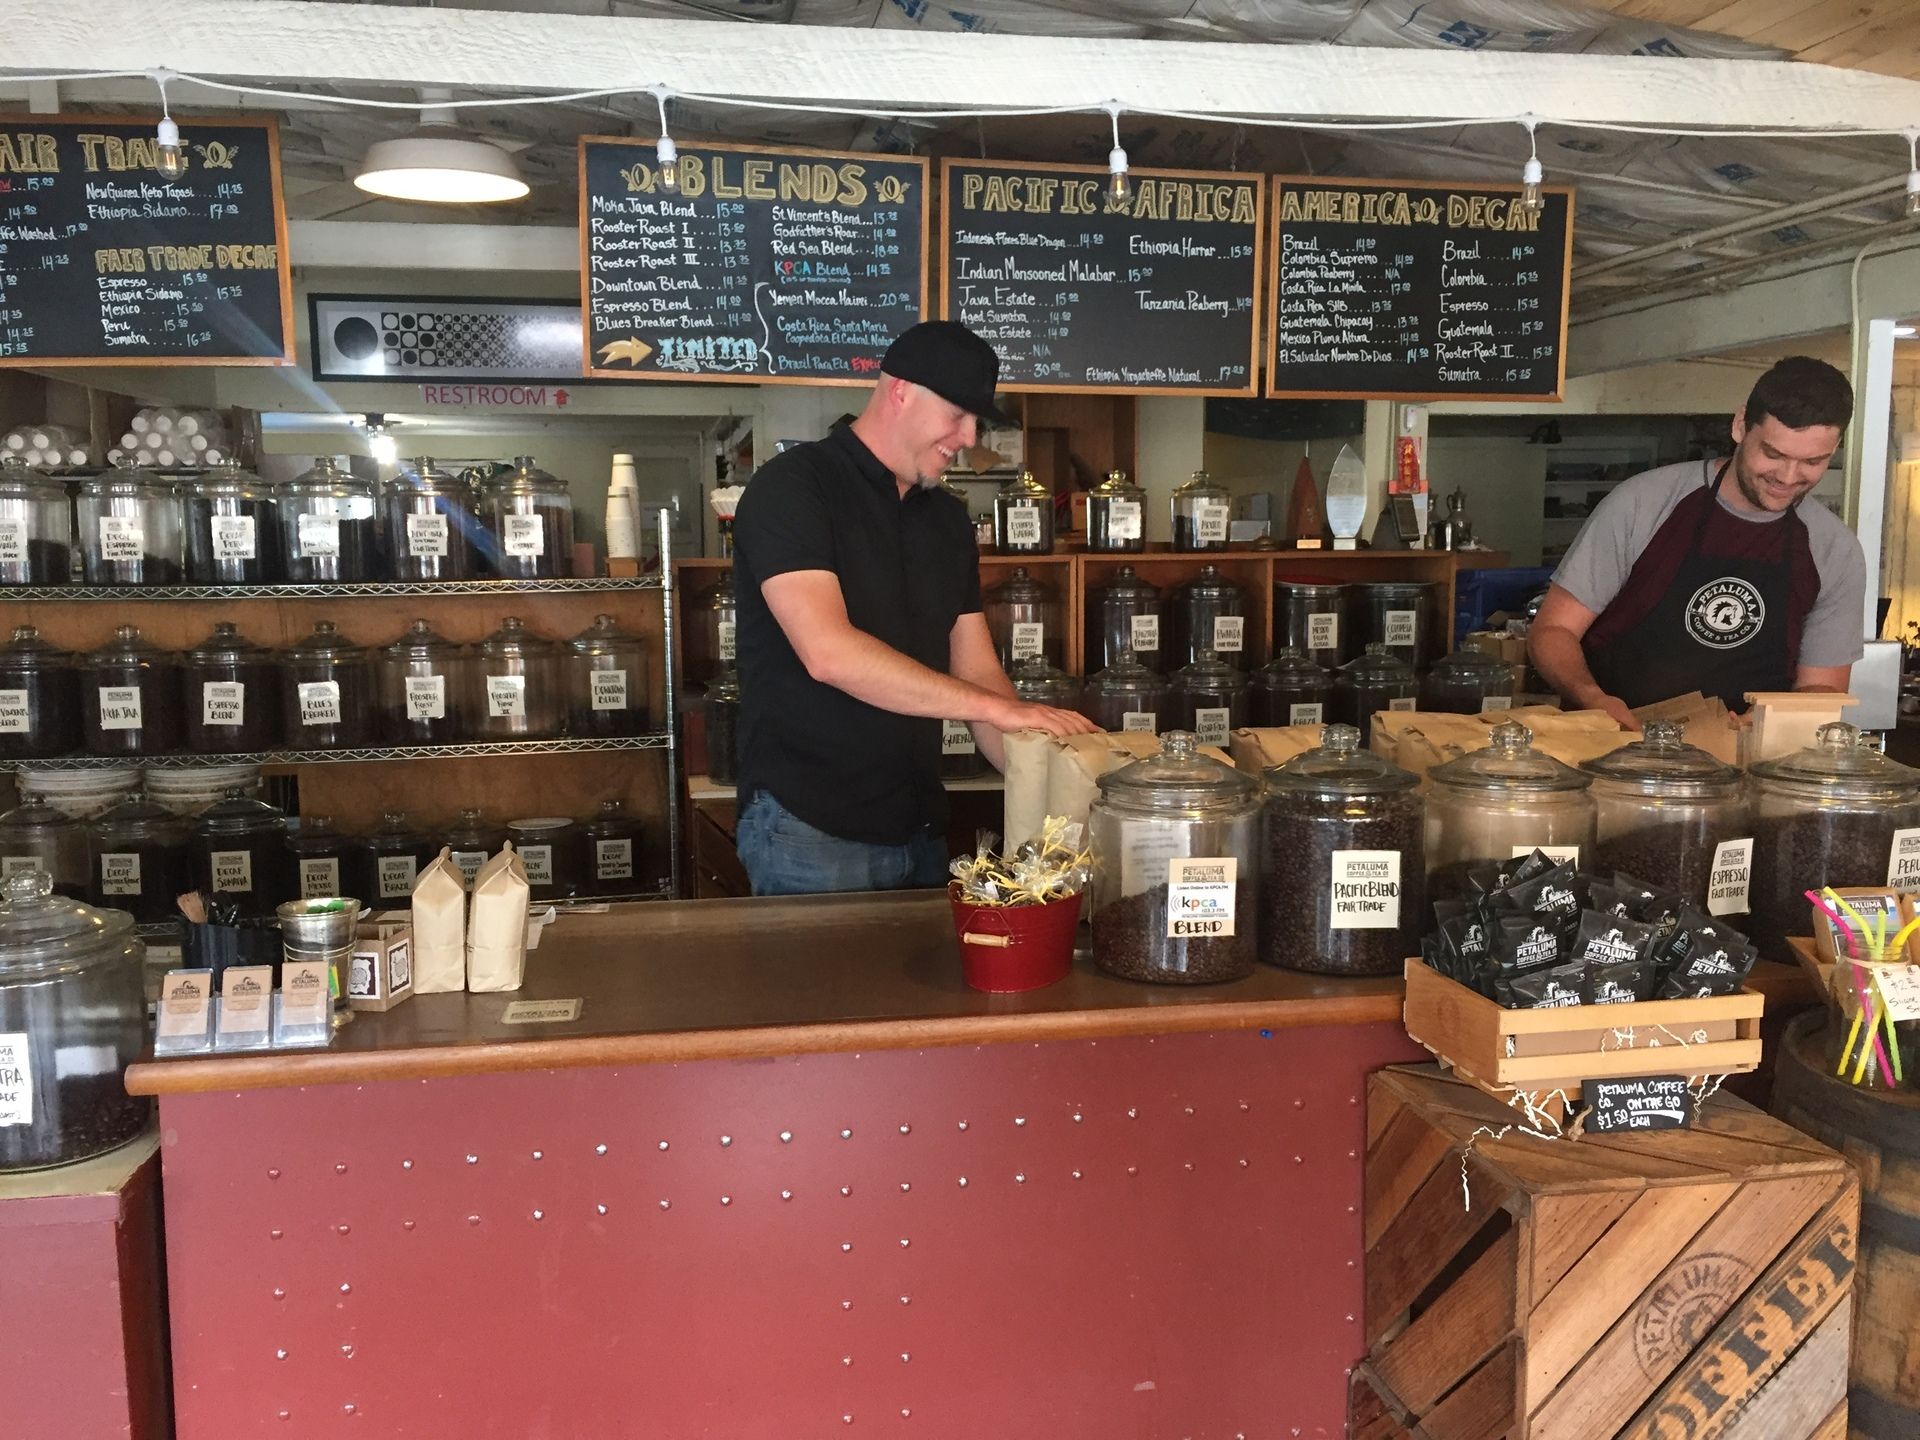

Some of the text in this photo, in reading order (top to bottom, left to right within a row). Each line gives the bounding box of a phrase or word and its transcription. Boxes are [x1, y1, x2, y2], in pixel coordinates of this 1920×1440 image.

[680, 154, 868, 207] BLENDS
[141, 182, 162, 199] Keto
[962, 174, 1256, 224] PACIFIC AFRICA
[87, 204, 187, 221] Ethiopia Sidamo
[592, 196, 625, 213] Moka
[626, 197, 658, 216] Java
[660, 201, 697, 217] Blend
[1281, 191, 1411, 225] AMERICA
[786, 208, 861, 225] Vincent's Blend
[22, 227, 57, 240] Washed
[591, 218, 636, 234] Rooster
[637, 219, 675, 234] Roast
[774, 223, 858, 241] Godfather's Roar
[592, 237, 695, 252] Rooster Roast II
[771, 240, 856, 256] Red Sea Blend
[1129, 235, 1181, 257] Ethiopia
[1283, 234, 1320, 251] Brazil
[1443, 240, 1481, 262] Brazil
[96, 244, 279, 273] FAIR TRADE DECAF
[591, 254, 700, 272] Rooster Roast III
[1282, 251, 1378, 266] Colombia Supremo
[774, 261, 851, 276] KPCA Blend
[956, 256, 1117, 282] Indian Monsooned Malabar
[1281, 266, 1319, 280] Colombia
[1317, 265, 1355, 281] Peaberry
[1441, 264, 1487, 287] Colombia
[97, 276, 148, 289] Espresso
[591, 275, 702, 295] Downtown Blend
[1281, 280, 1341, 295] Costa Rica La
[99, 288, 184, 303] Ethiopia Sidamo
[769, 289, 838, 306] Yemen Mocca
[959, 285, 1036, 307] Java Estate
[1135, 290, 1229, 318] Tanzania Peaberry
[1440, 293, 1489, 313] Espresso
[101, 305, 141, 317] Mexico
[591, 297, 649, 315] Espresso
[650, 296, 693, 312] Blend
[1280, 299, 1306, 313] Costa
[595, 314, 714, 331] Blues Breaker Blend
[777, 316, 888, 334] Costa Rica Santa Maria
[961, 308, 986, 325] Aged
[1280, 315, 1332, 329] Guatemala
[102, 318, 130, 333] Peru
[999, 326, 1031, 339] Estate
[1438, 318, 1494, 340] Guatemala
[104, 333, 150, 346] Sumatra
[1280, 332, 1311, 346] Mexico
[1342, 330, 1370, 344] Altura
[778, 353, 811, 369] Brazil
[1280, 347, 1392, 364] El Salvador Nombre Dios
[1434, 342, 1514, 364] Rooster Roast II
[1086, 366, 1120, 382] Ethiopia
[1168, 368, 1202, 383] Natural
[1439, 367, 1482, 382] Sumatra
[424, 386, 547, 406] RESTROOM
[1699, 585, 1756, 611] PETALUMA
[1694, 617, 1714, 638] COFFEE
[208, 700, 240, 710] ESPRESSO
[306, 699, 333, 709] BLUES
[210, 711, 236, 720] BLEND
[302, 709, 337, 721] BREAKER
[106, 868, 133, 877] DECAF
[217, 868, 242, 877] DECAF
[383, 872, 408, 882] DECAF
[1712, 867, 1748, 886] ESPRESSO
[1334, 881, 1400, 899] PACIFIC BLEND
[1712, 886, 1745, 899] FAIR TRADE
[1182, 896, 1217, 911] kpca
[1337, 901, 1387, 913] FAIR TRADE
[1174, 920, 1222, 934] BLEND
[1516, 939, 1557, 958] PETALUMA
[1584, 951, 1608, 963] COFFEE
[1586, 942, 1637, 961] PETALUMA
[1516, 954, 1535, 963] COFFEE
[1597, 1080, 1685, 1096] PETALUMA COFFEE
[1598, 1098, 1681, 1112] CO. ON THE GO
[1597, 1110, 1650, 1130] $1.50 EACH
